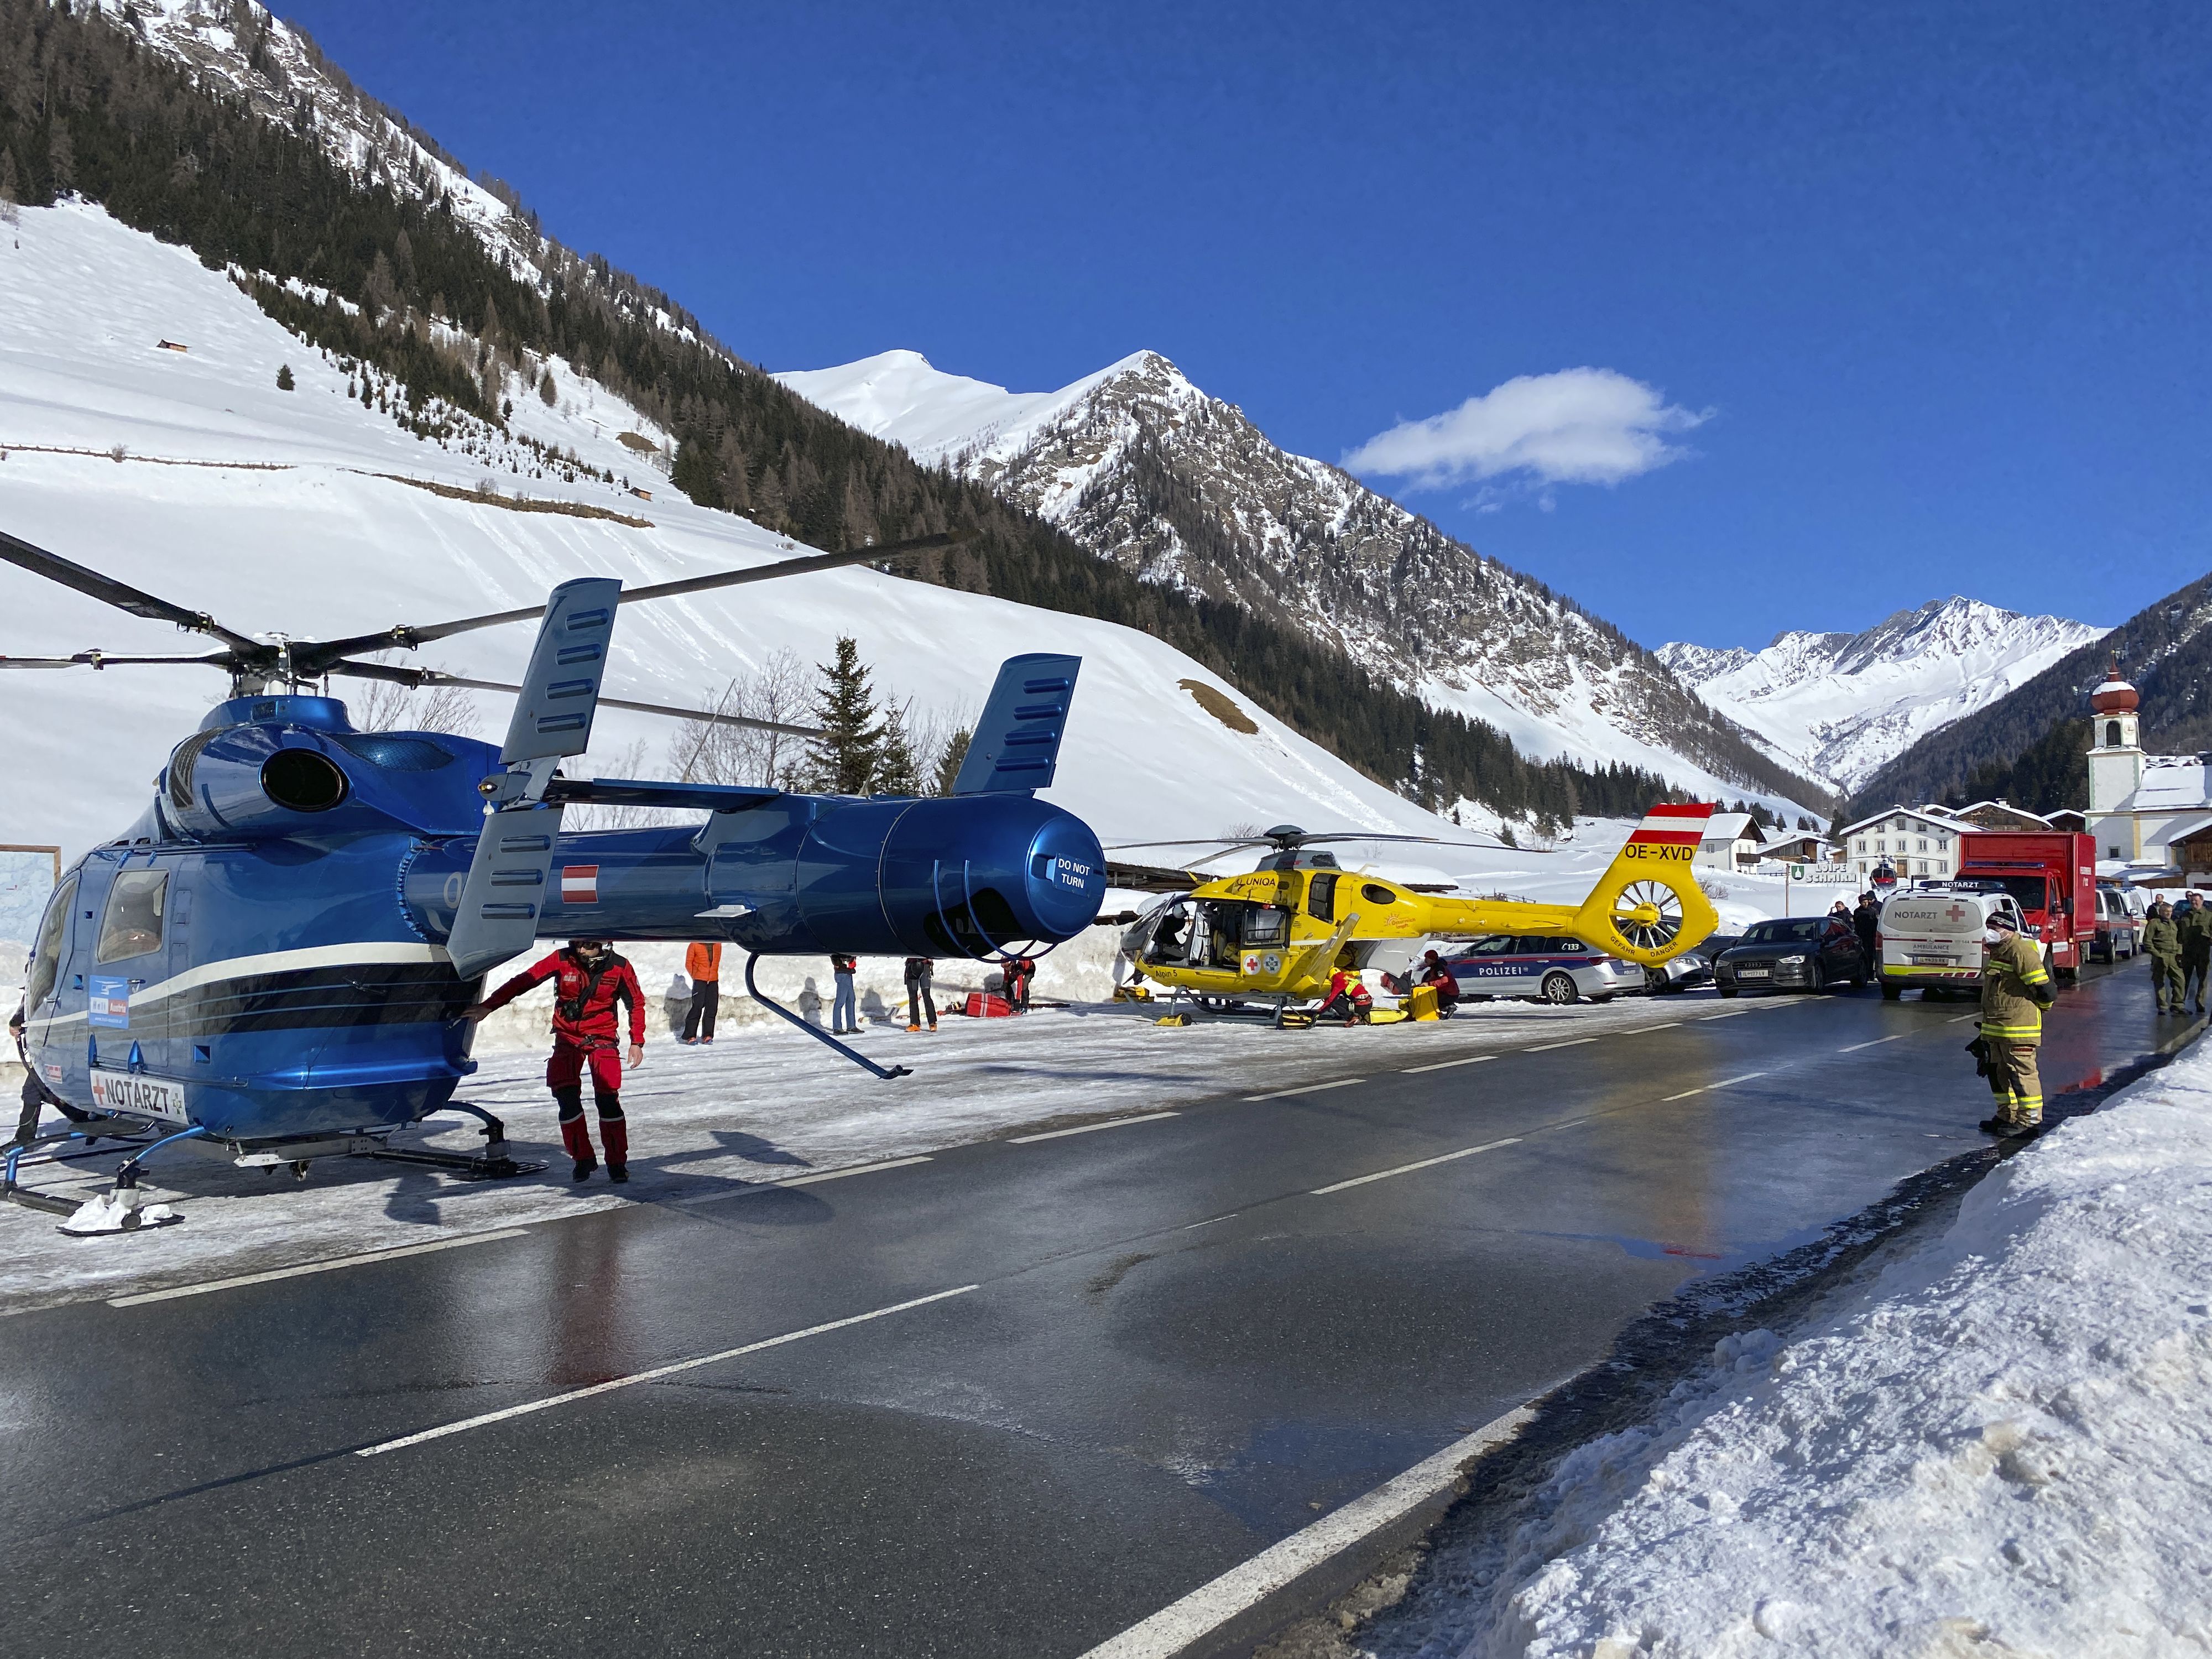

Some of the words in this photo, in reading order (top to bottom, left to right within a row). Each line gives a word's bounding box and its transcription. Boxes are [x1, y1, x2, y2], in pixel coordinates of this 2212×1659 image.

[1625, 844, 1693, 860] OE-XVD
[1058, 858, 1071, 870] DO
[1073, 863, 1091, 876] NOT
[1815, 862, 1846, 873] LOIPE
[1061, 873, 1084, 889] TURN
[1246, 878, 1276, 886] UNIQA
[1806, 874, 1856, 883] SCHMIRN
[1610, 936, 1635, 956] GEFAHR
[1650, 942, 1678, 957] DANGER
[1156, 970, 1172, 978] Alpin
[1479, 967, 1521, 975] POLIZEI
[93, 1001, 106, 1010] Heli
[105, 1079, 168, 1114] NOTARZT
